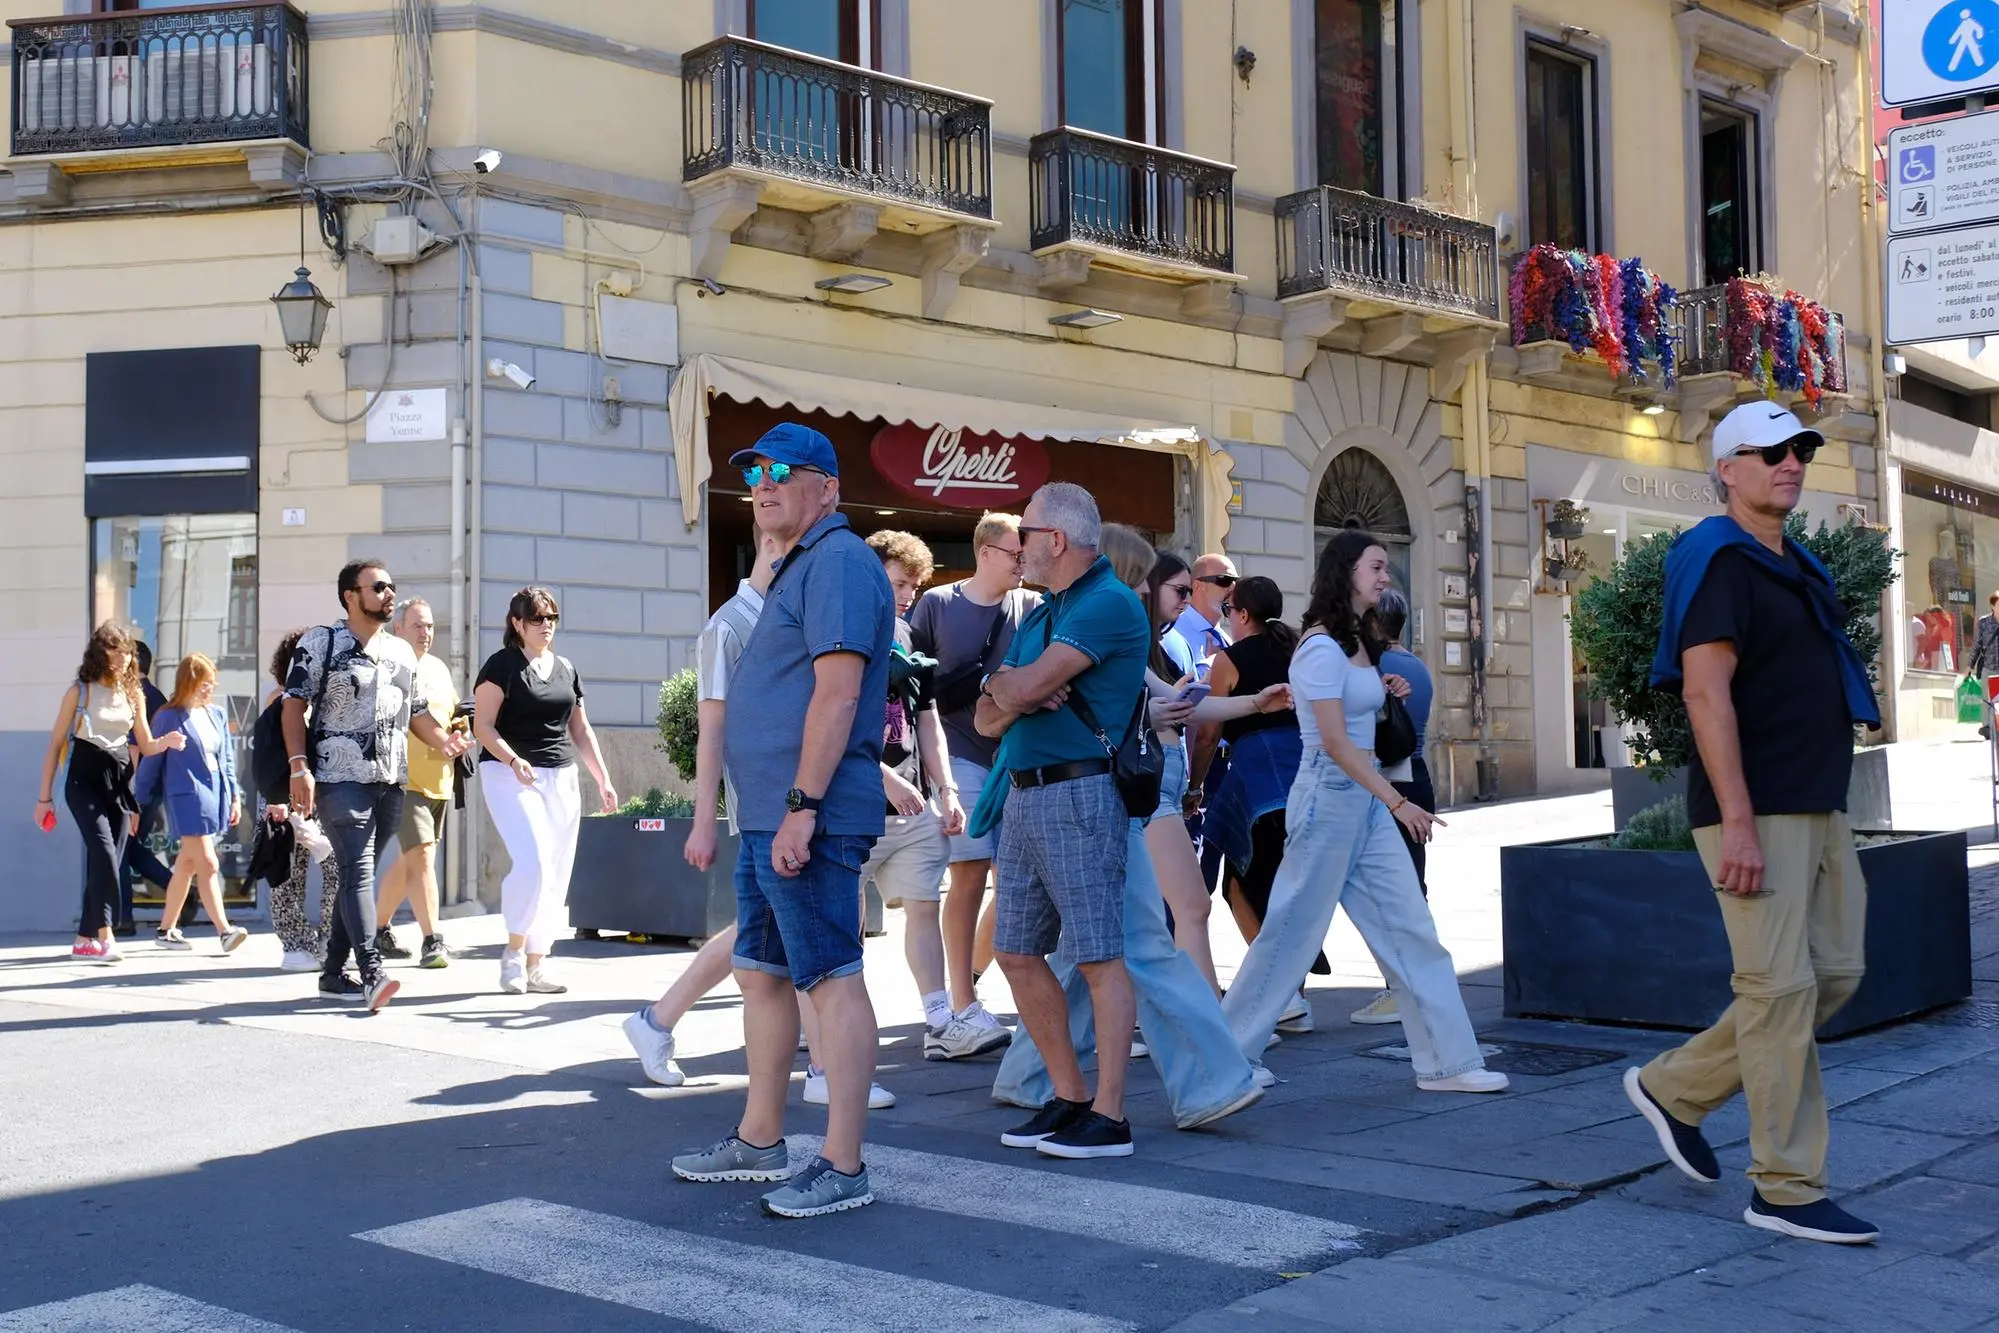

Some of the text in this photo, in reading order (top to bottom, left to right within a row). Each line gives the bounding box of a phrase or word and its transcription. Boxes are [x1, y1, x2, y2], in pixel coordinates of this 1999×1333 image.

[1900, 128, 1945, 143] eccetto:
[1955, 150, 1992, 163] SERVIZIO
[1958, 158, 1997, 171] PERSONE
[1938, 244, 1951, 255] dal
[1938, 255, 1968, 267] eccetto
[1945, 281, 1973, 292] veicoli
[1945, 293, 1983, 306] residenti
[1937, 307, 1995, 323] orario 8:00
[390, 412, 422, 422] Piazza
[391, 426, 423, 436] Yenne
[922, 424, 1017, 496] Operti
